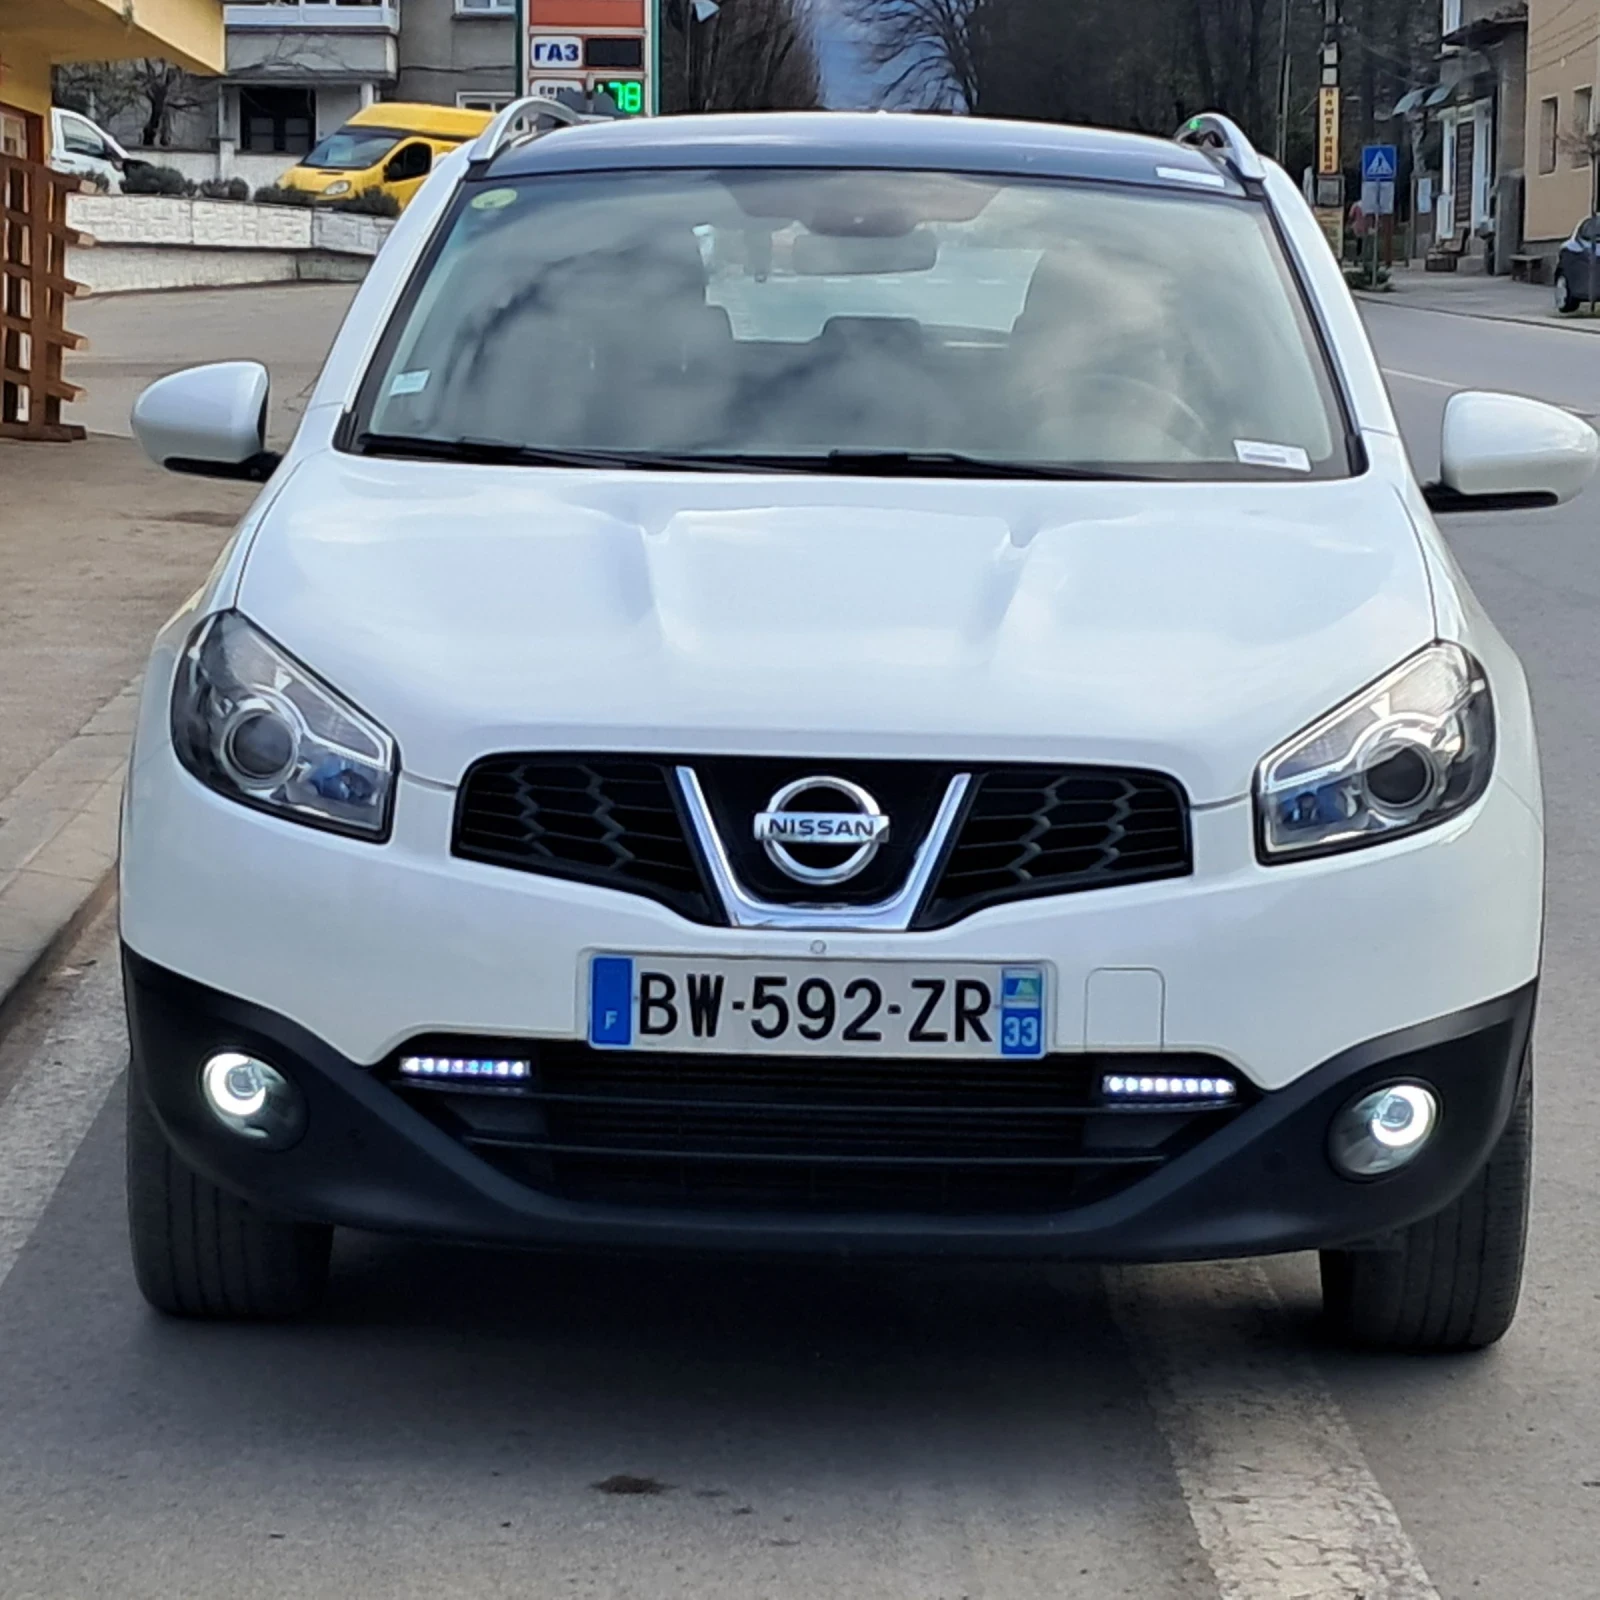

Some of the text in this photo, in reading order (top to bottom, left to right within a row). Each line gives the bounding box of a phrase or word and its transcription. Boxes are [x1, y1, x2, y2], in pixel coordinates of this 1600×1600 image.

[534, 43, 580, 62] ГАЗ
[768, 818, 874, 837] NISSAN
[638, 970, 993, 1043] BW-592-ZR
[604, 1010, 618, 1030] F
[1004, 1016, 1039, 1047] 33
